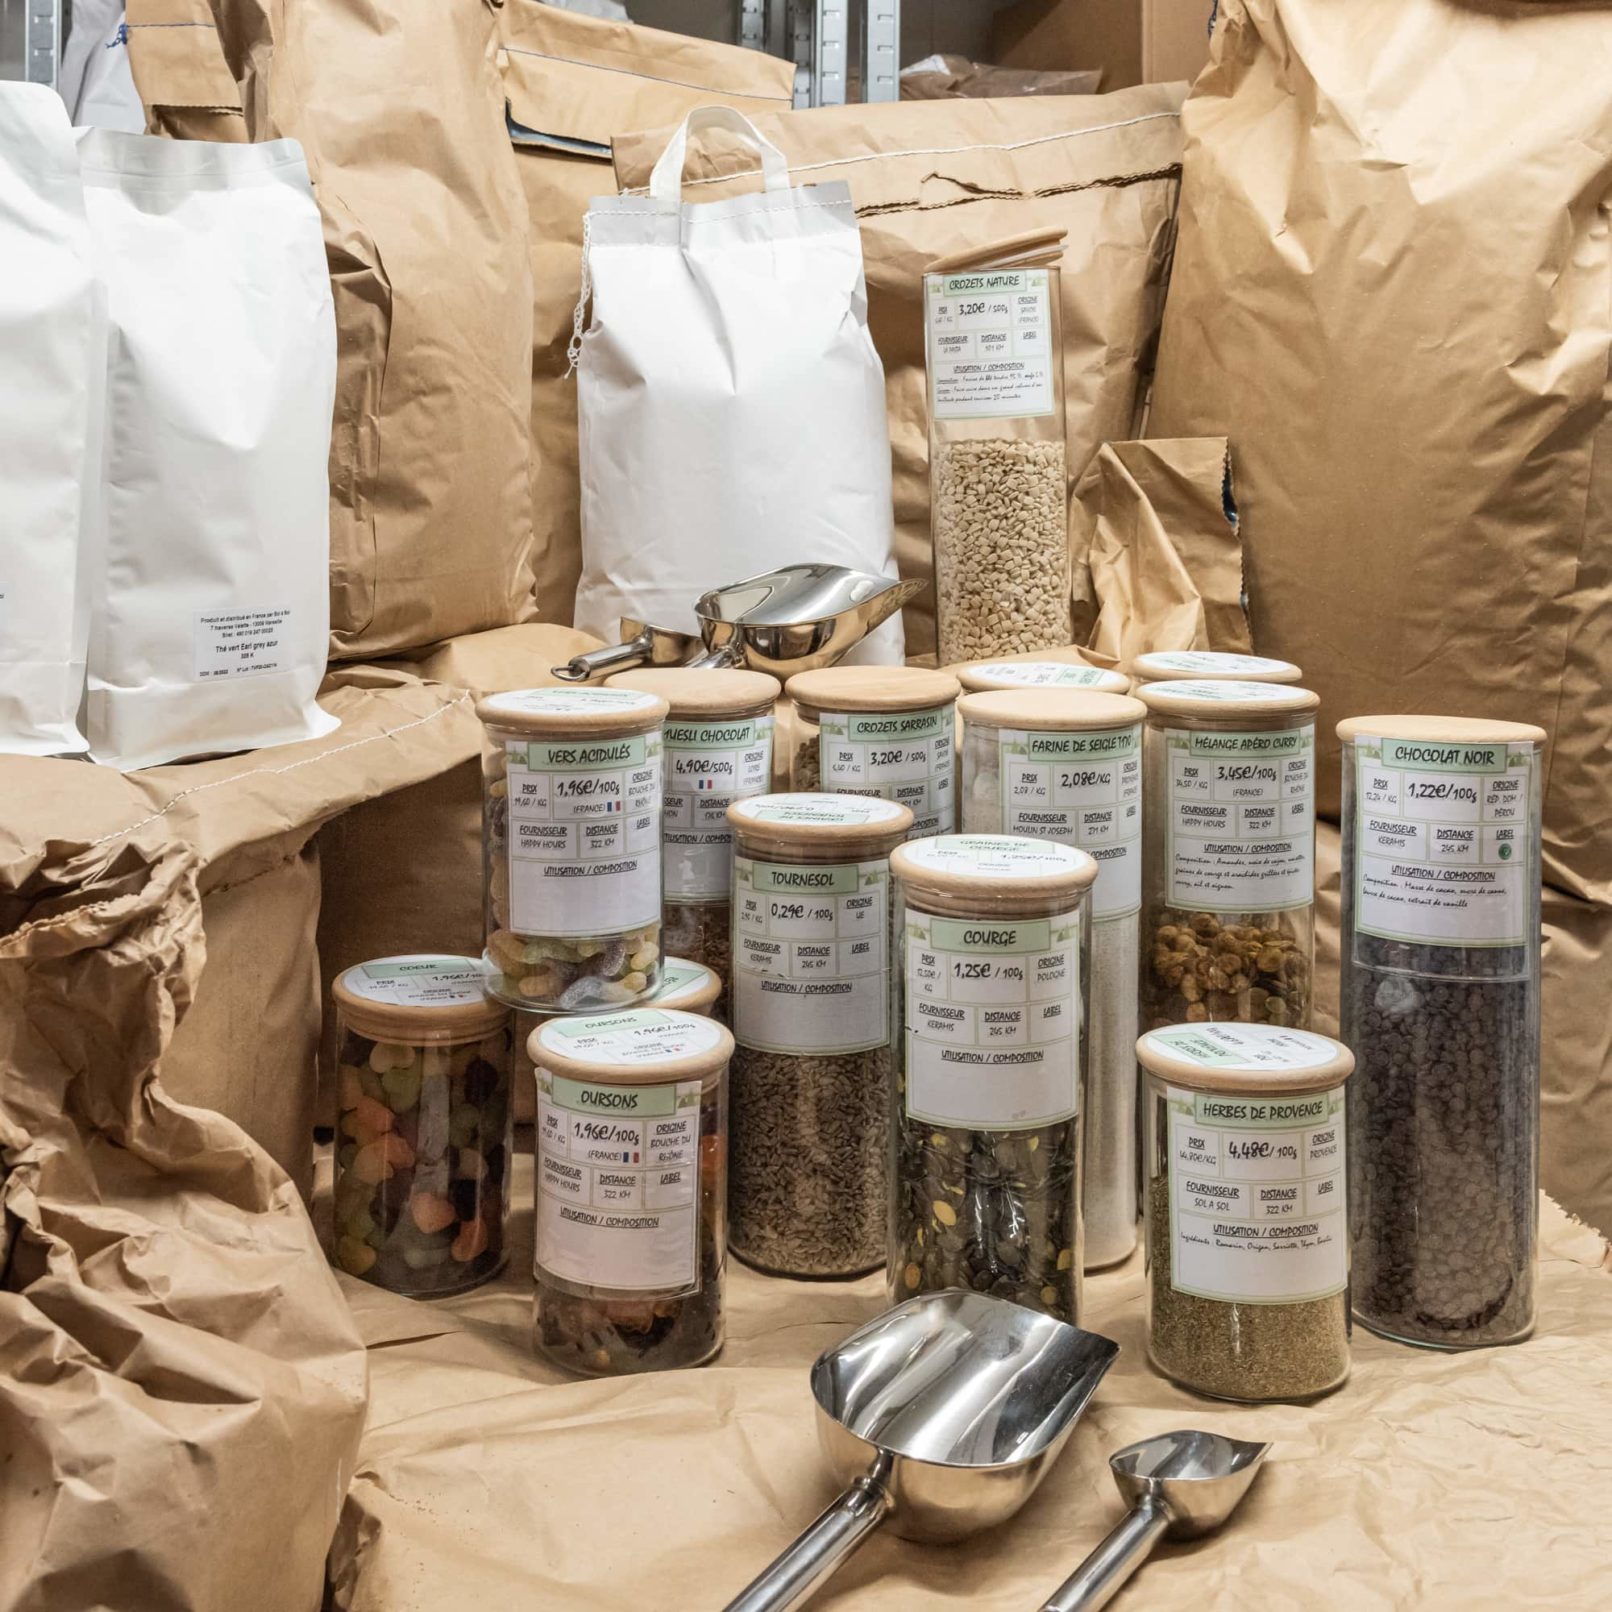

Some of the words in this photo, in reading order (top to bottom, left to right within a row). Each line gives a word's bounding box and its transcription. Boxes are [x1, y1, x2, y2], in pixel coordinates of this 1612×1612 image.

[950, 278, 984, 290] CROZETS
[987, 275, 1020, 287] NATURE
[959, 302, 986, 315] 3,20€
[253, 642, 265, 650] grey
[857, 722, 898, 733] CROZETS
[901, 716, 937, 731] SARRASIN
[701, 727, 750, 742] CHOCOLAT
[1032, 740, 1070, 752] FARINE
[1073, 740, 1086, 751] DE
[1089, 737, 1117, 750] SEIGLE
[1195, 736, 1238, 750] MÉLANGE
[1240, 737, 1270, 750] APÉRO
[1273, 736, 1297, 748] CURRY
[548, 750, 576, 763] VERS
[579, 744, 631, 762] ACIDULÉS
[870, 751, 902, 765] 3,20€
[1395, 747, 1460, 765] CHOCOLAT
[1464, 750, 1495, 765] NOIR
[1061, 772, 1111, 788] 2,08€/KG
[1408, 782, 1477, 803] 1,22€/100g
[1084, 811, 1112, 823] DISTANCE
[1181, 805, 1227, 816] FOURNISSEUR
[1244, 808, 1276, 818] DISTANCE
[1018, 813, 1067, 823] FOURNISSEUR
[520, 824, 568, 835] FOURNISSEUR
[586, 824, 619, 835] DISTANCE
[1370, 821, 1417, 836] FOURNISSEUR
[1437, 830, 1474, 840] DISTANCE
[542, 840, 566, 849] HOURS
[1204, 844, 1244, 853] UTILISATION
[1251, 842, 1292, 853] COMPOSITION
[544, 864, 584, 876] UTILISATION
[593, 861, 637, 874] COMPOSITION
[1391, 865, 1434, 880] UTILISATION
[1444, 871, 1496, 882] COMPOSITION
[772, 872, 834, 886] TOURNESOL
[771, 903, 804, 919] 0,29€
[815, 910, 833, 921] 100g
[963, 931, 1016, 944] COURGE
[797, 947, 830, 956] DISTANCE
[954, 963, 991, 978] 1,25€
[1003, 968, 1023, 980] 100g
[761, 980, 797, 992] UTILISATION
[805, 983, 852, 994] COMPOSITION
[919, 1003, 965, 1020] FOURNISSEUR
[985, 1011, 1021, 1022] DISTANCE
[941, 1050, 984, 1062] UTILISATION
[993, 1050, 1044, 1063] COMPOSITION
[581, 1090, 638, 1108] OURSONS
[1204, 1103, 1247, 1118] HERBES
[1250, 1106, 1266, 1119] DE
[1270, 1101, 1322, 1119] PROVENCE
[656, 1121, 686, 1135] ORIGINE
[1278, 1146, 1297, 1160] 100g
[600, 1174, 636, 1186] DISTANCE
[660, 1172, 681, 1184] LABEL
[1186, 1181, 1240, 1199] FOURNISSEUR
[1260, 1188, 1297, 1200] DISTANCE
[560, 1206, 598, 1224] UTILISATION
[606, 1216, 659, 1228] COMPOSITION
[1213, 1224, 1260, 1237] UTILISATION
[1269, 1223, 1318, 1237] COMPOSITION
